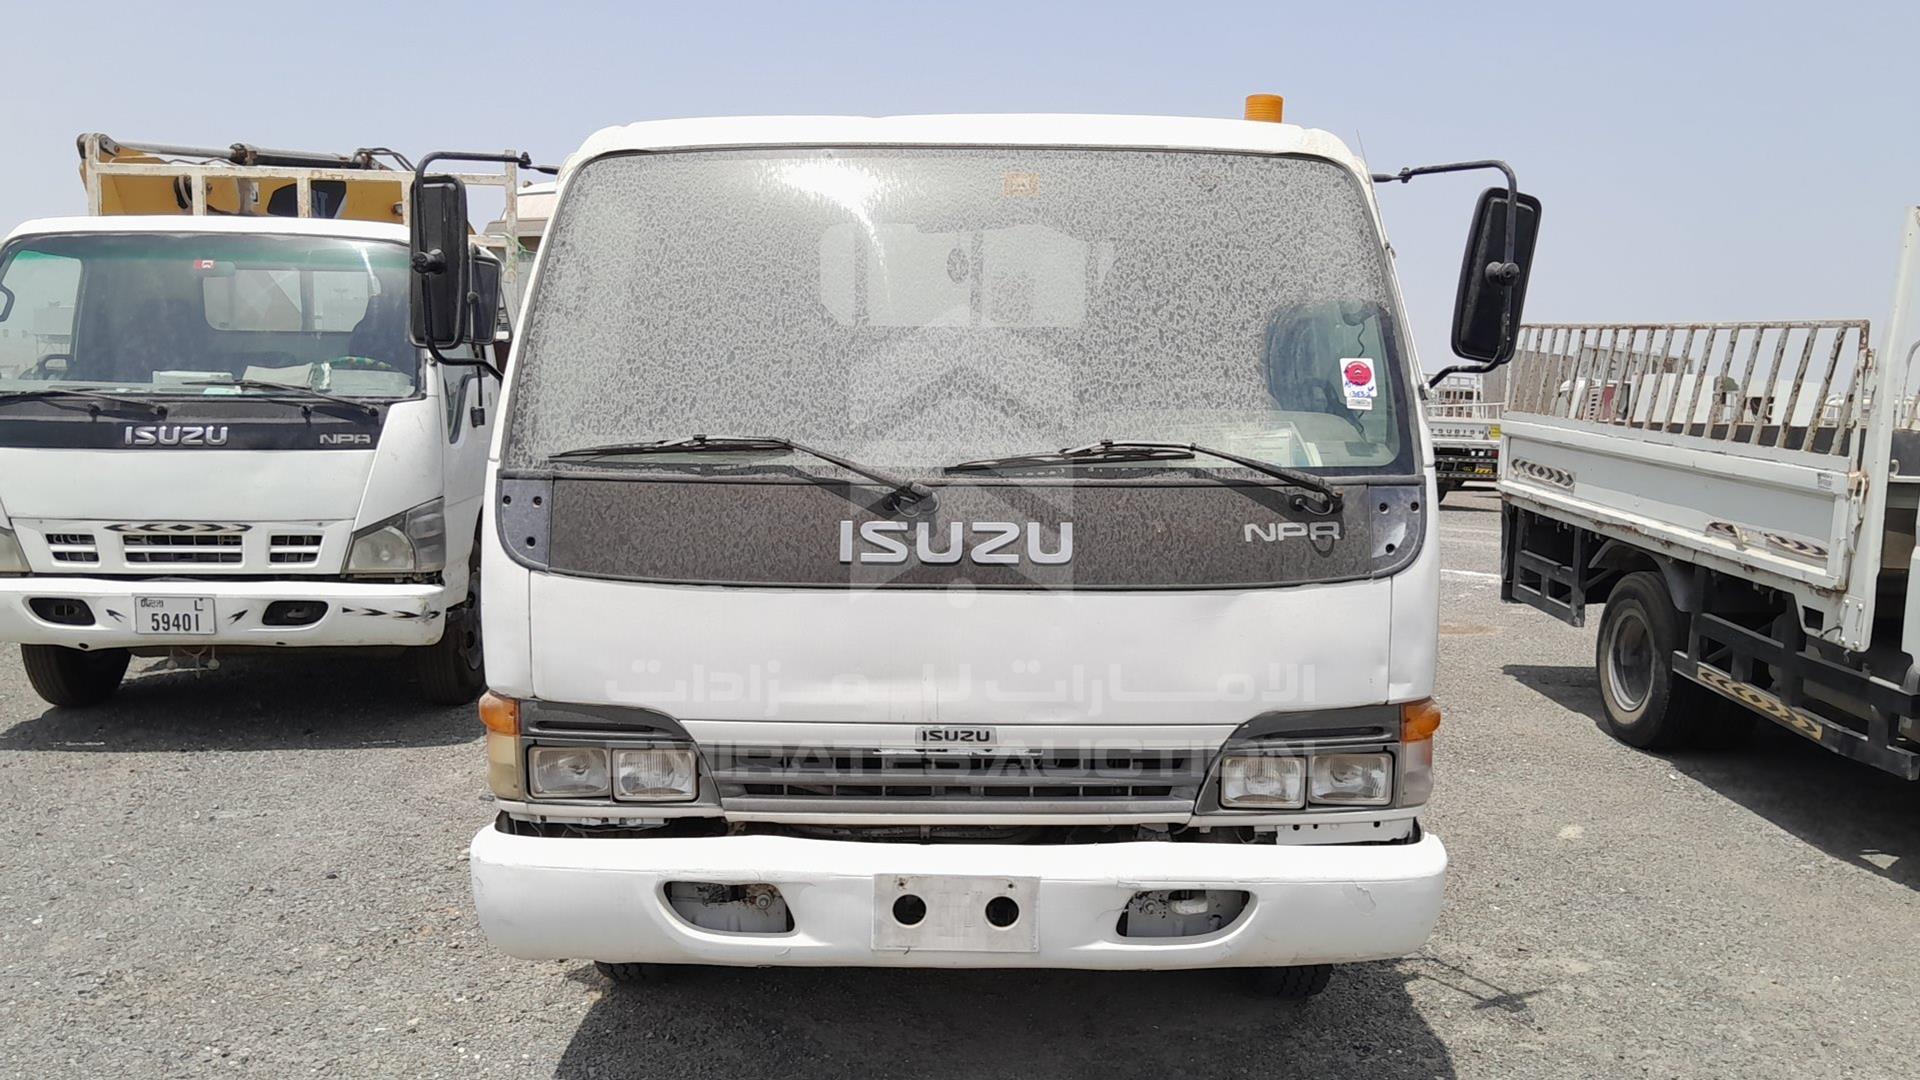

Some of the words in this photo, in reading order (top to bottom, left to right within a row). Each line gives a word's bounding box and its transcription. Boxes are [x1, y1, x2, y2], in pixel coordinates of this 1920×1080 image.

[125, 425, 229, 446] ISUZU
[319, 433, 372, 445] NPR
[1244, 521, 1341, 542] NPR
[839, 520, 1074, 566] ISUZU
[151, 612, 200, 632] 59401
[922, 730, 990, 742] ISUZU
